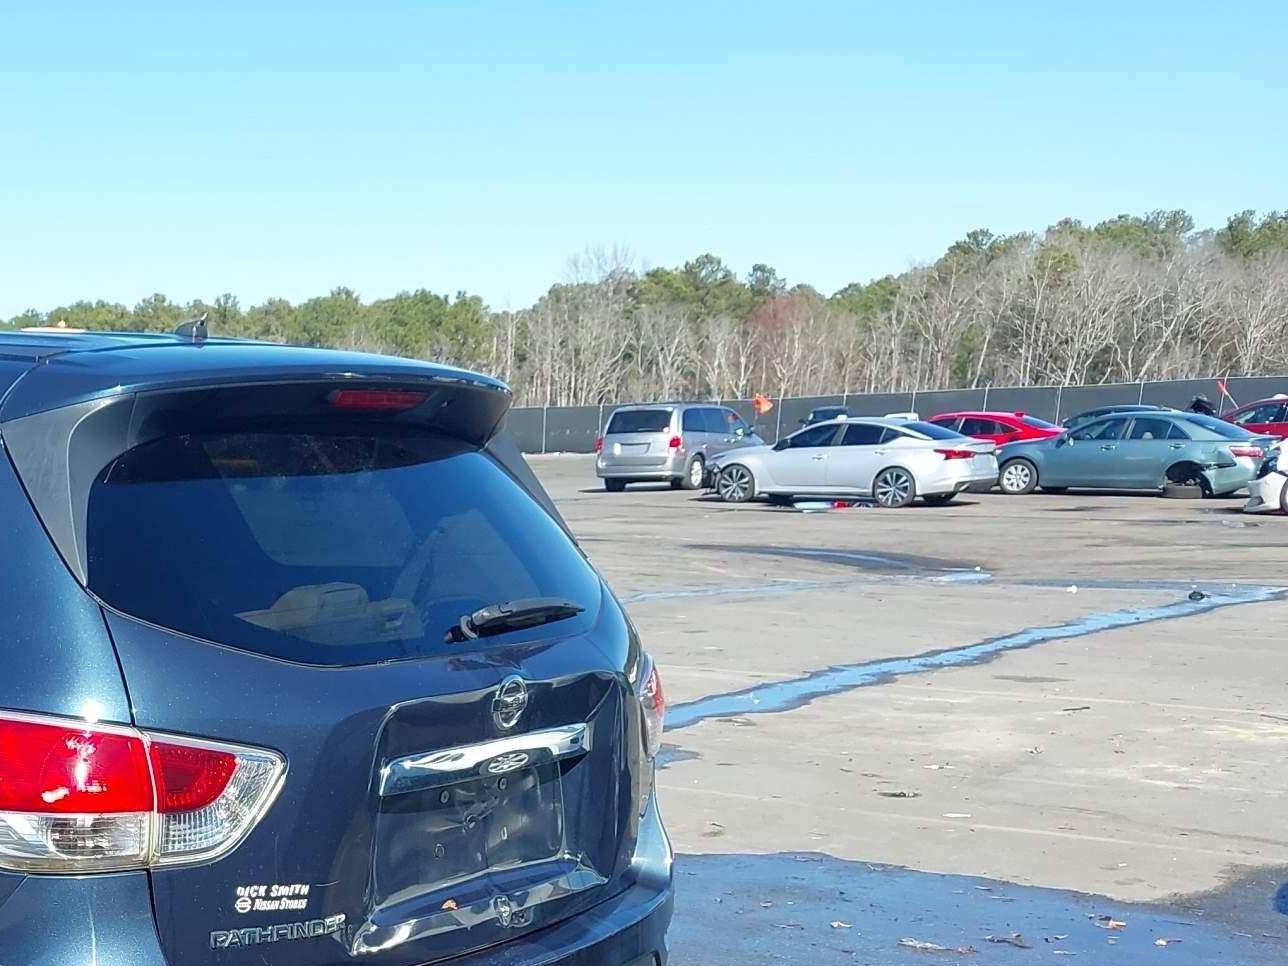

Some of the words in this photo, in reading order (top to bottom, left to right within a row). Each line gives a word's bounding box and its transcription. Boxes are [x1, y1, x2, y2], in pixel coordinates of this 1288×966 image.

[236, 885, 267, 898] DICK
[270, 884, 310, 897] SMITH
[210, 913, 347, 950] PATHFINDER
